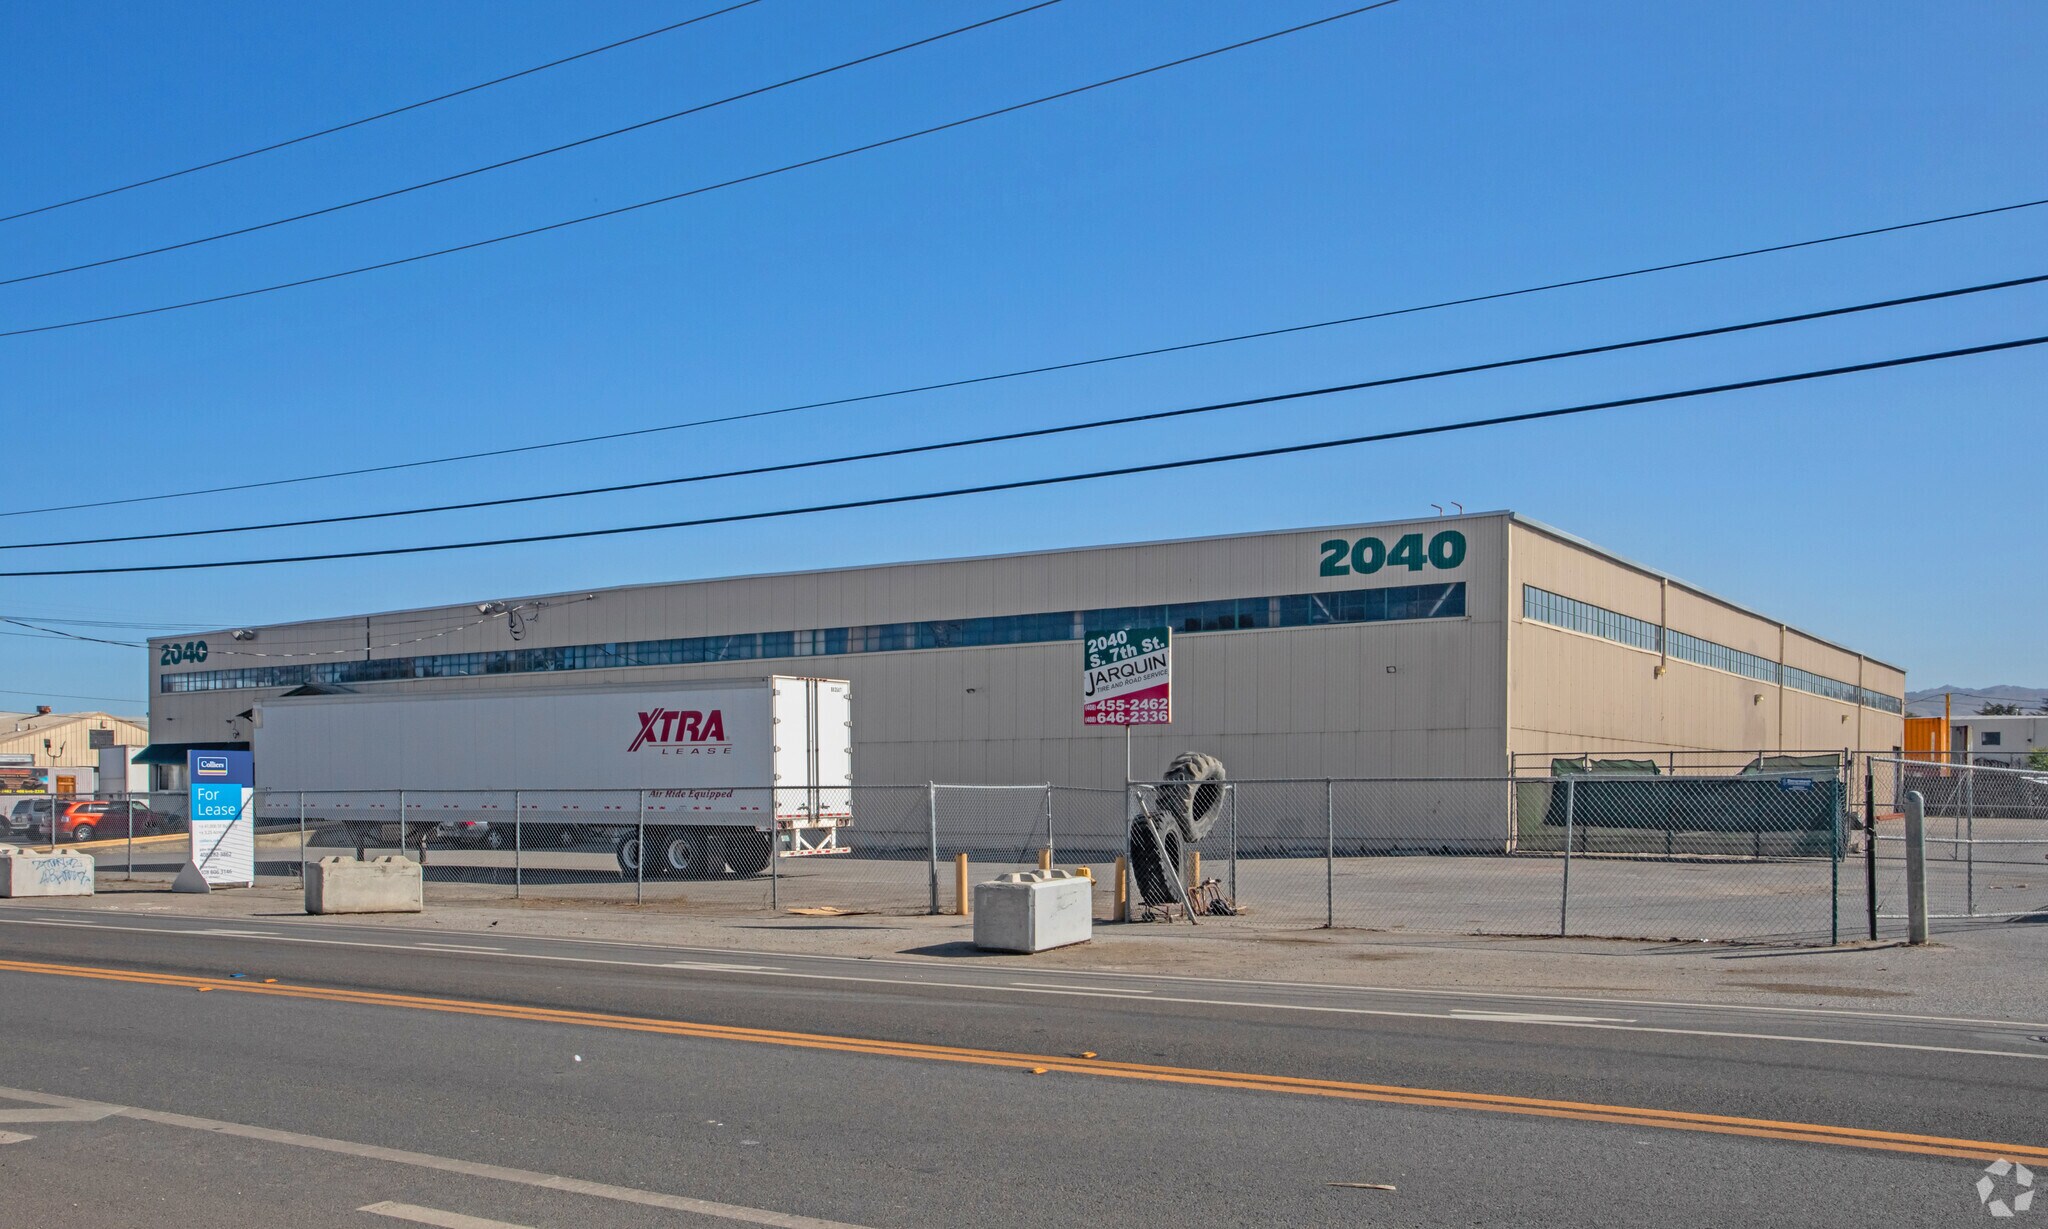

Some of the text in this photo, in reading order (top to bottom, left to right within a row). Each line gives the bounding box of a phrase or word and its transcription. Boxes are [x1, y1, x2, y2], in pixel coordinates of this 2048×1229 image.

[1320, 530, 1467, 577] 2040
[1087, 631, 1127, 653] 2040
[161, 641, 208, 666] 2040
[1089, 636, 1165, 667] S. 7th St.
[1085, 654, 1167, 697] JARQUIN
[1097, 669, 1168, 693] TIRE AND ROAD SERVICE
[1097, 699, 1168, 711] 455-2462
[1097, 711, 1168, 723] 646-2336
[627, 708, 725, 752] XTRA
[662, 747, 732, 755] LEASE
[201, 760, 224, 768] Colliers
[198, 788, 219, 801] For
[649, 789, 734, 800] Air Ride Equipped
[198, 803, 236, 816] Lease
